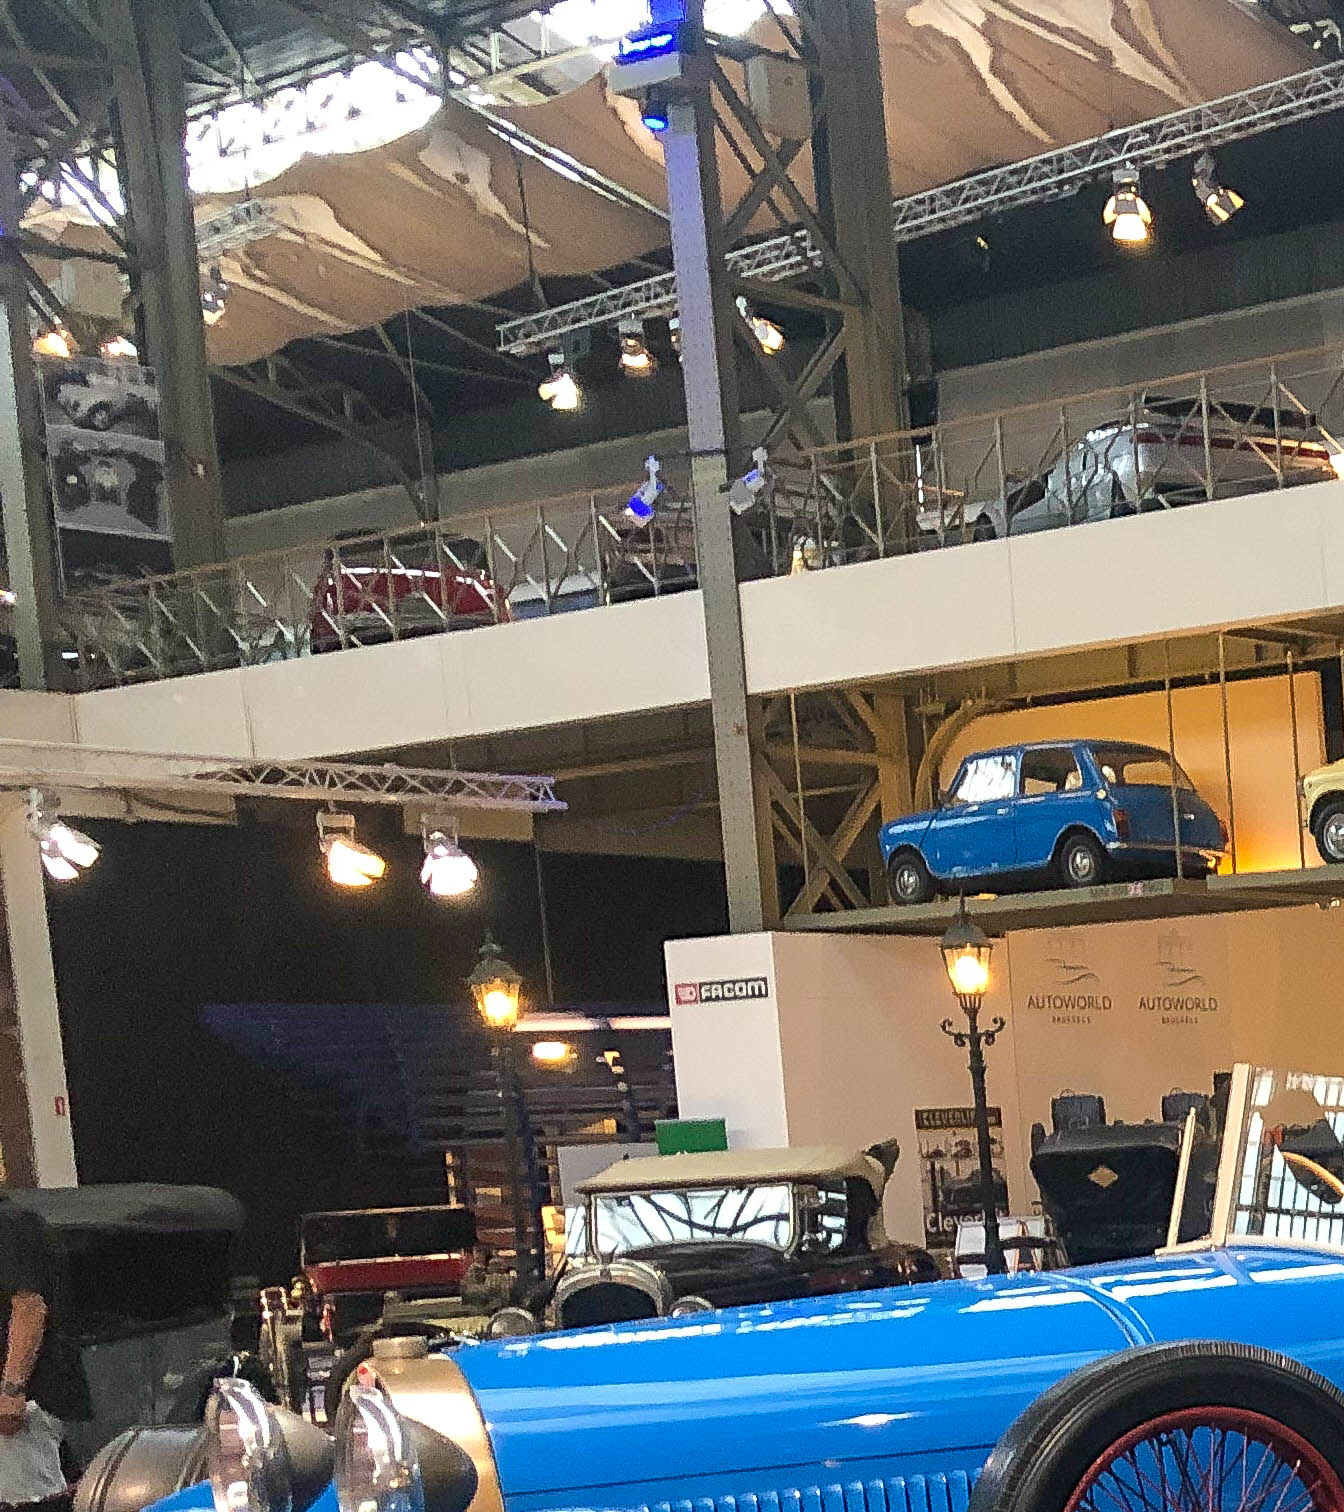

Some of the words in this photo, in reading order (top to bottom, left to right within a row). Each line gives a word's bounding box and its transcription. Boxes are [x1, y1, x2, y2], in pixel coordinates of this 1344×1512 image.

[700, 979, 766, 1000] FACOM
[1027, 995, 1113, 1011] AUTOWORLD
[1138, 996, 1219, 1012] AUTOWORLD
